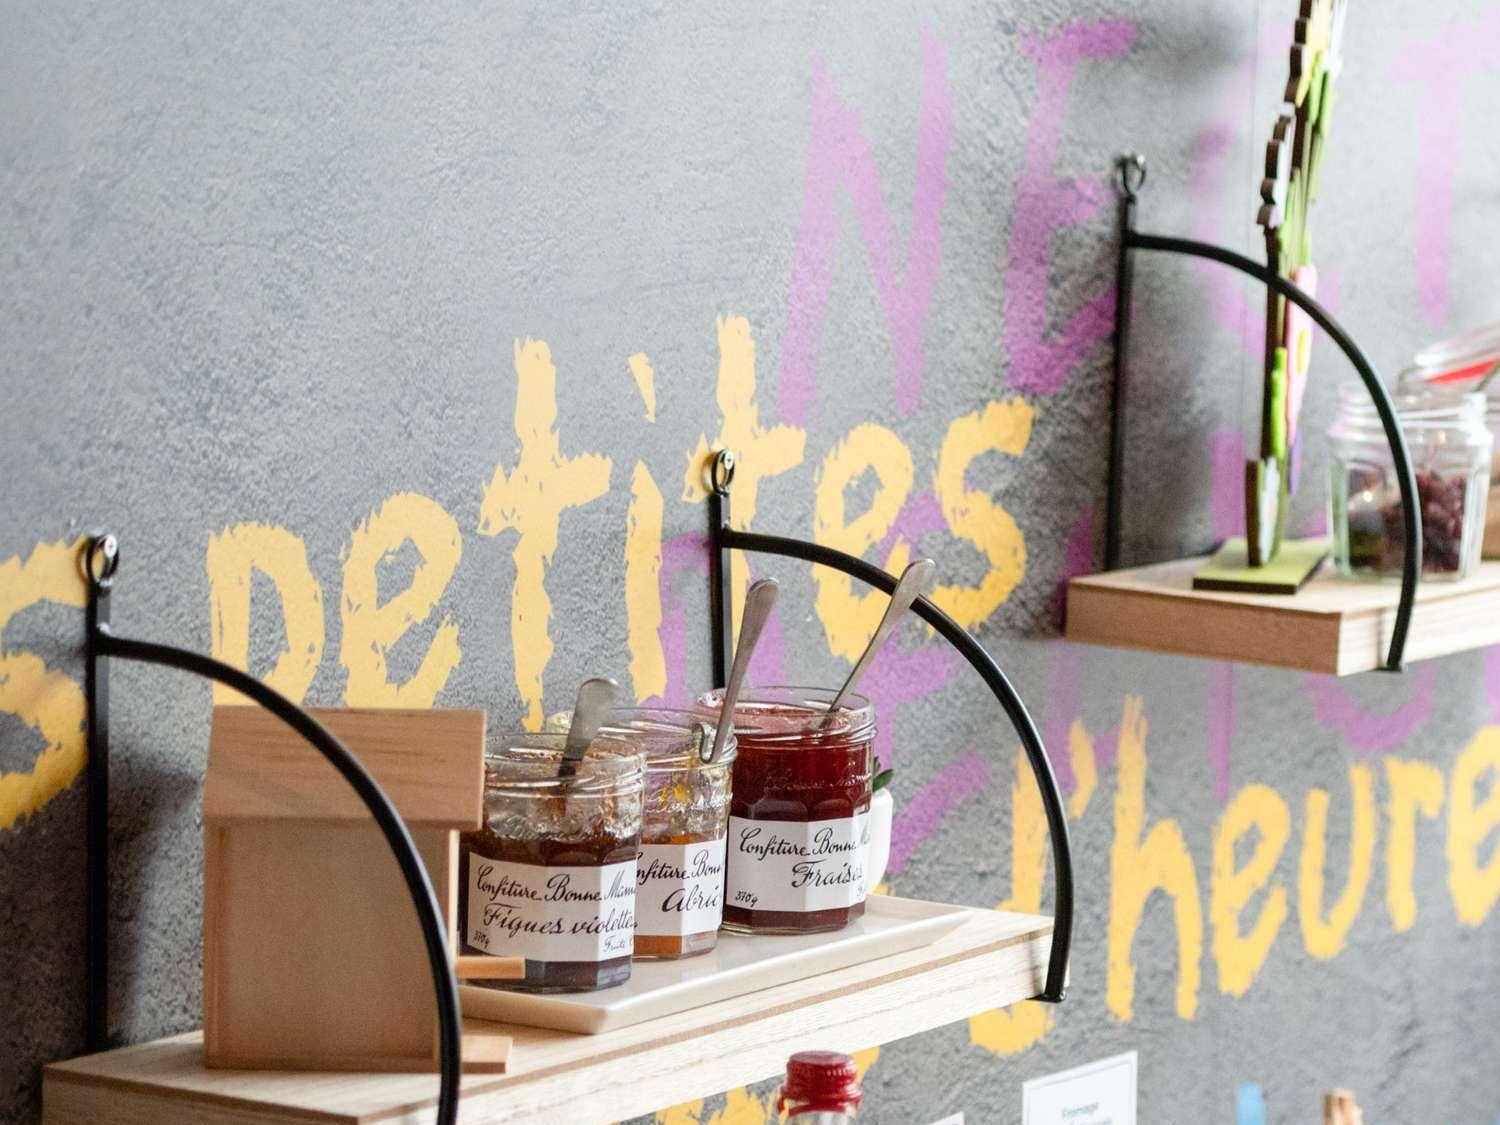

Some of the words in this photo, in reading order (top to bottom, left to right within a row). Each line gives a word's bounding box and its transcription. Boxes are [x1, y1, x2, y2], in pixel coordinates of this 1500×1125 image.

[739, 827, 810, 861] Confiture
[477, 864, 542, 901] Confiture
[544, 873, 602, 901] Bonne
[636, 851, 690, 886] nfiture
[482, 902, 565, 939] Figues
